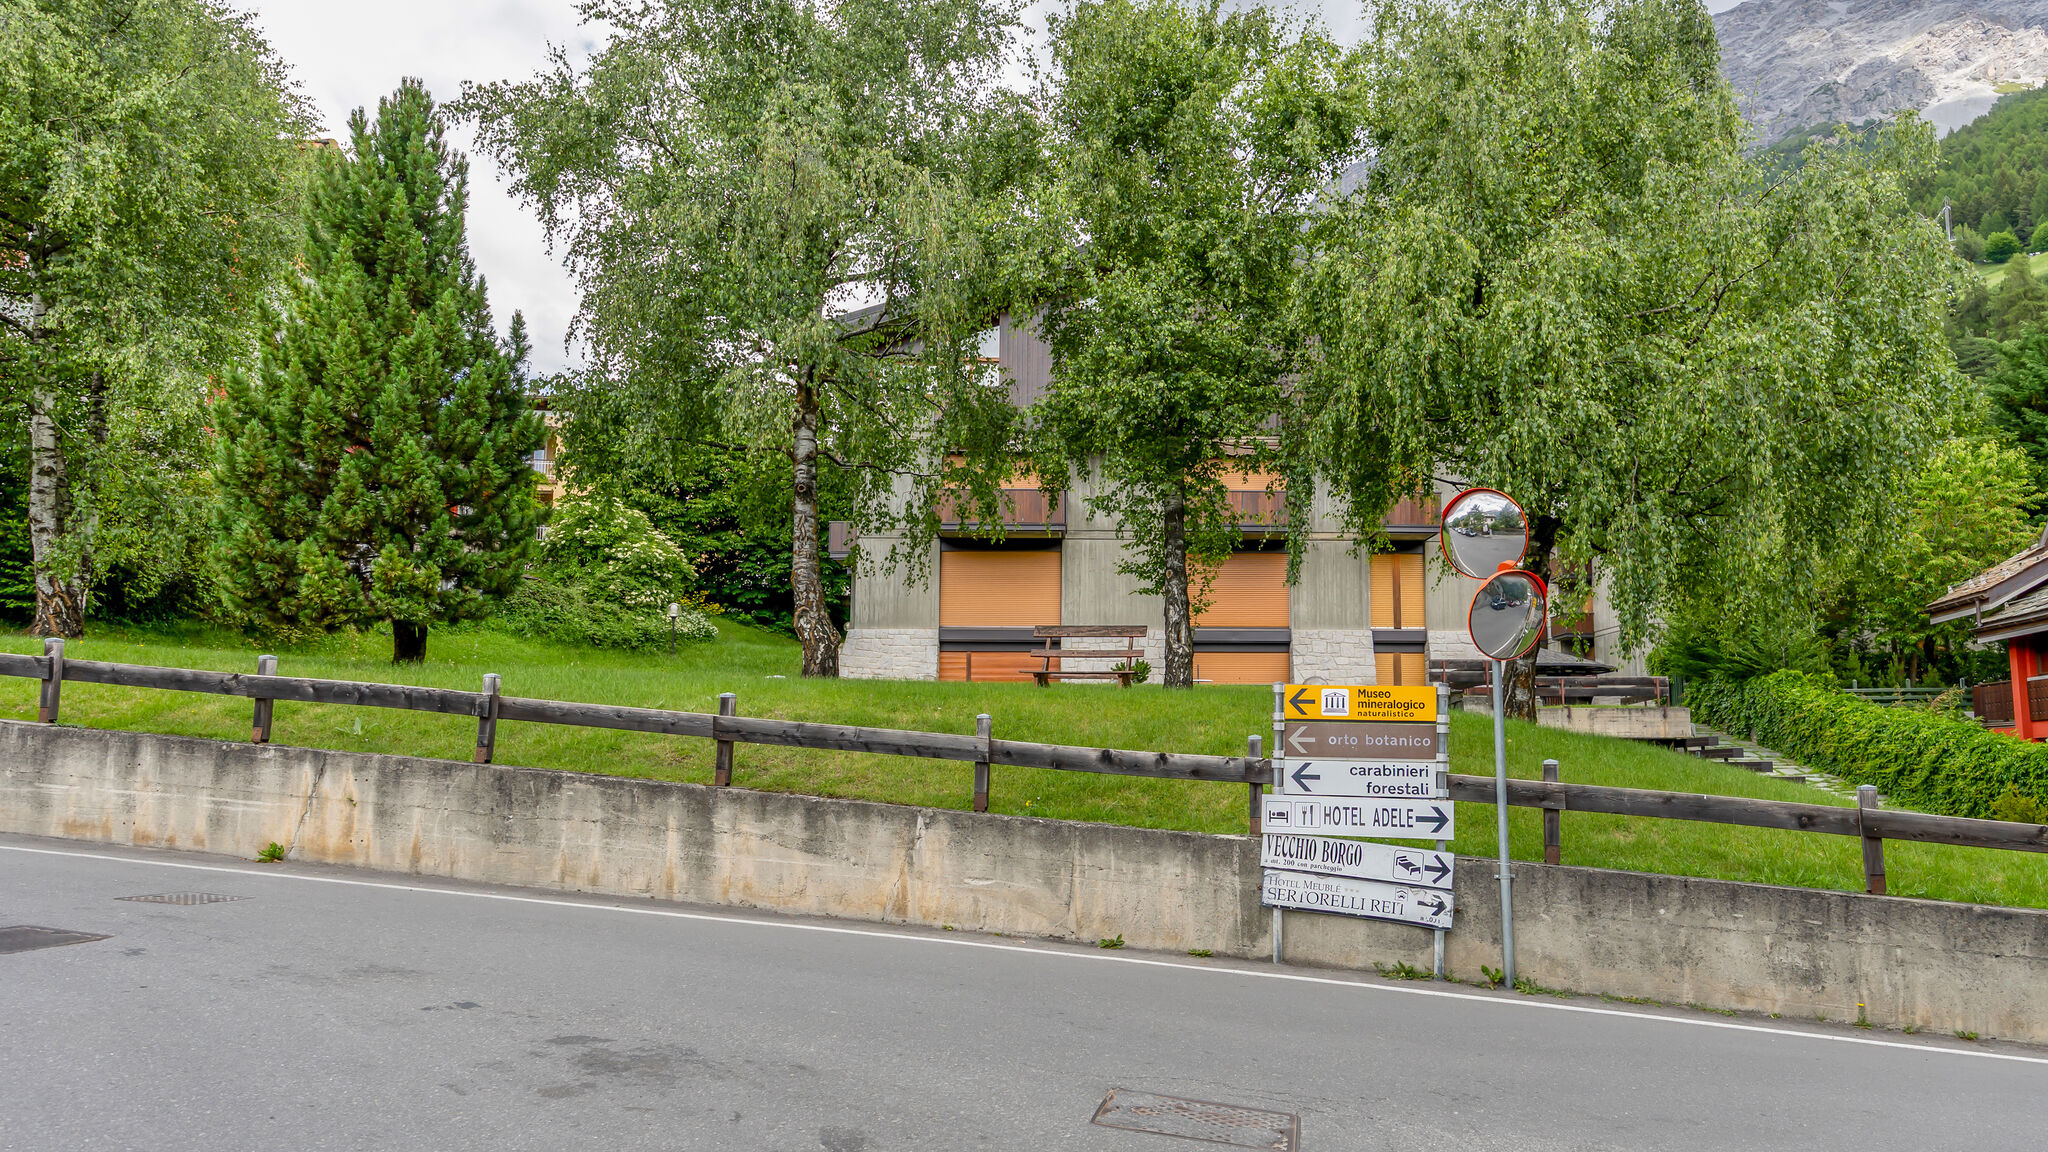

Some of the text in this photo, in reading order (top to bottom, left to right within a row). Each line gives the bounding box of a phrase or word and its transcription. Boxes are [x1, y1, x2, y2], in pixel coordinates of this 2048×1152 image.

[1357, 689, 1391, 699] Museo
[1357, 700, 1426, 712] mineralogico
[1357, 710, 1415, 718] naturalistico
[1328, 734, 1431, 747] orto botanico
[1349, 765, 1429, 778] carabinieri
[1366, 782, 1429, 796] forestali
[1323, 806, 1414, 828] HOTEL ADELE
[1267, 834, 1363, 867] VECCHIO BORGO
[1310, 863, 1343, 872] parcheggio
[1267, 887, 1366, 910] SERTORELLI
